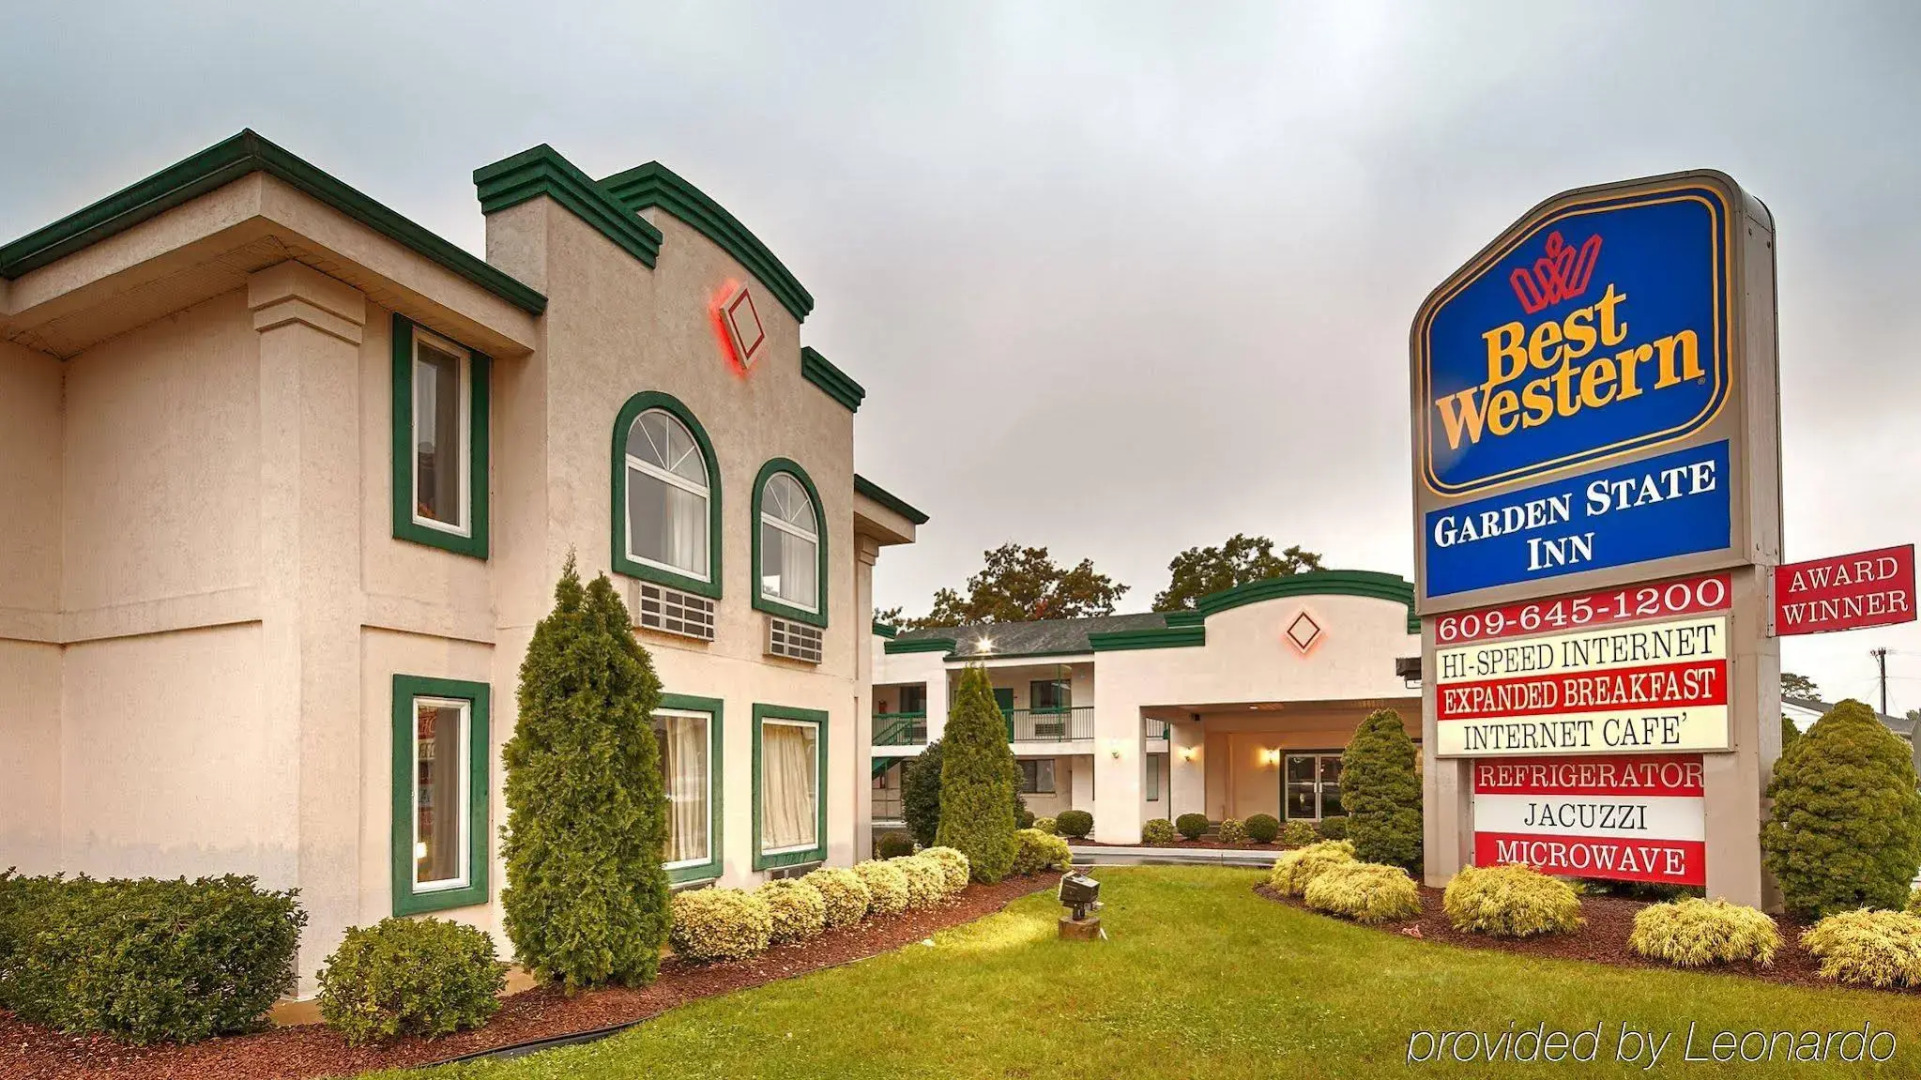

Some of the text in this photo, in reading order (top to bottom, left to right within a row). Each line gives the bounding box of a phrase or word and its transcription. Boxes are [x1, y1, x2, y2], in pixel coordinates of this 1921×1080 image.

[1482, 284, 1627, 386] Best
[1435, 329, 1705, 450] Western
[1434, 460, 1716, 548] GARDEN STATE
[1527, 533, 1596, 571] INN
[1788, 556, 1899, 593] AWARD
[1439, 579, 1725, 641] 609-645-1200
[1782, 590, 1909, 625] WINNER
[1442, 624, 1717, 679] HI-SPEED INTERNET
[1443, 667, 1716, 715] EXPANDED BREAKFAST
[1463, 720, 1594, 750] INTERNET
[1478, 763, 1704, 788] REFRIGERATOR
[1524, 803, 1648, 830] JACUZZI
[1496, 840, 1686, 876] MICROWAVE
